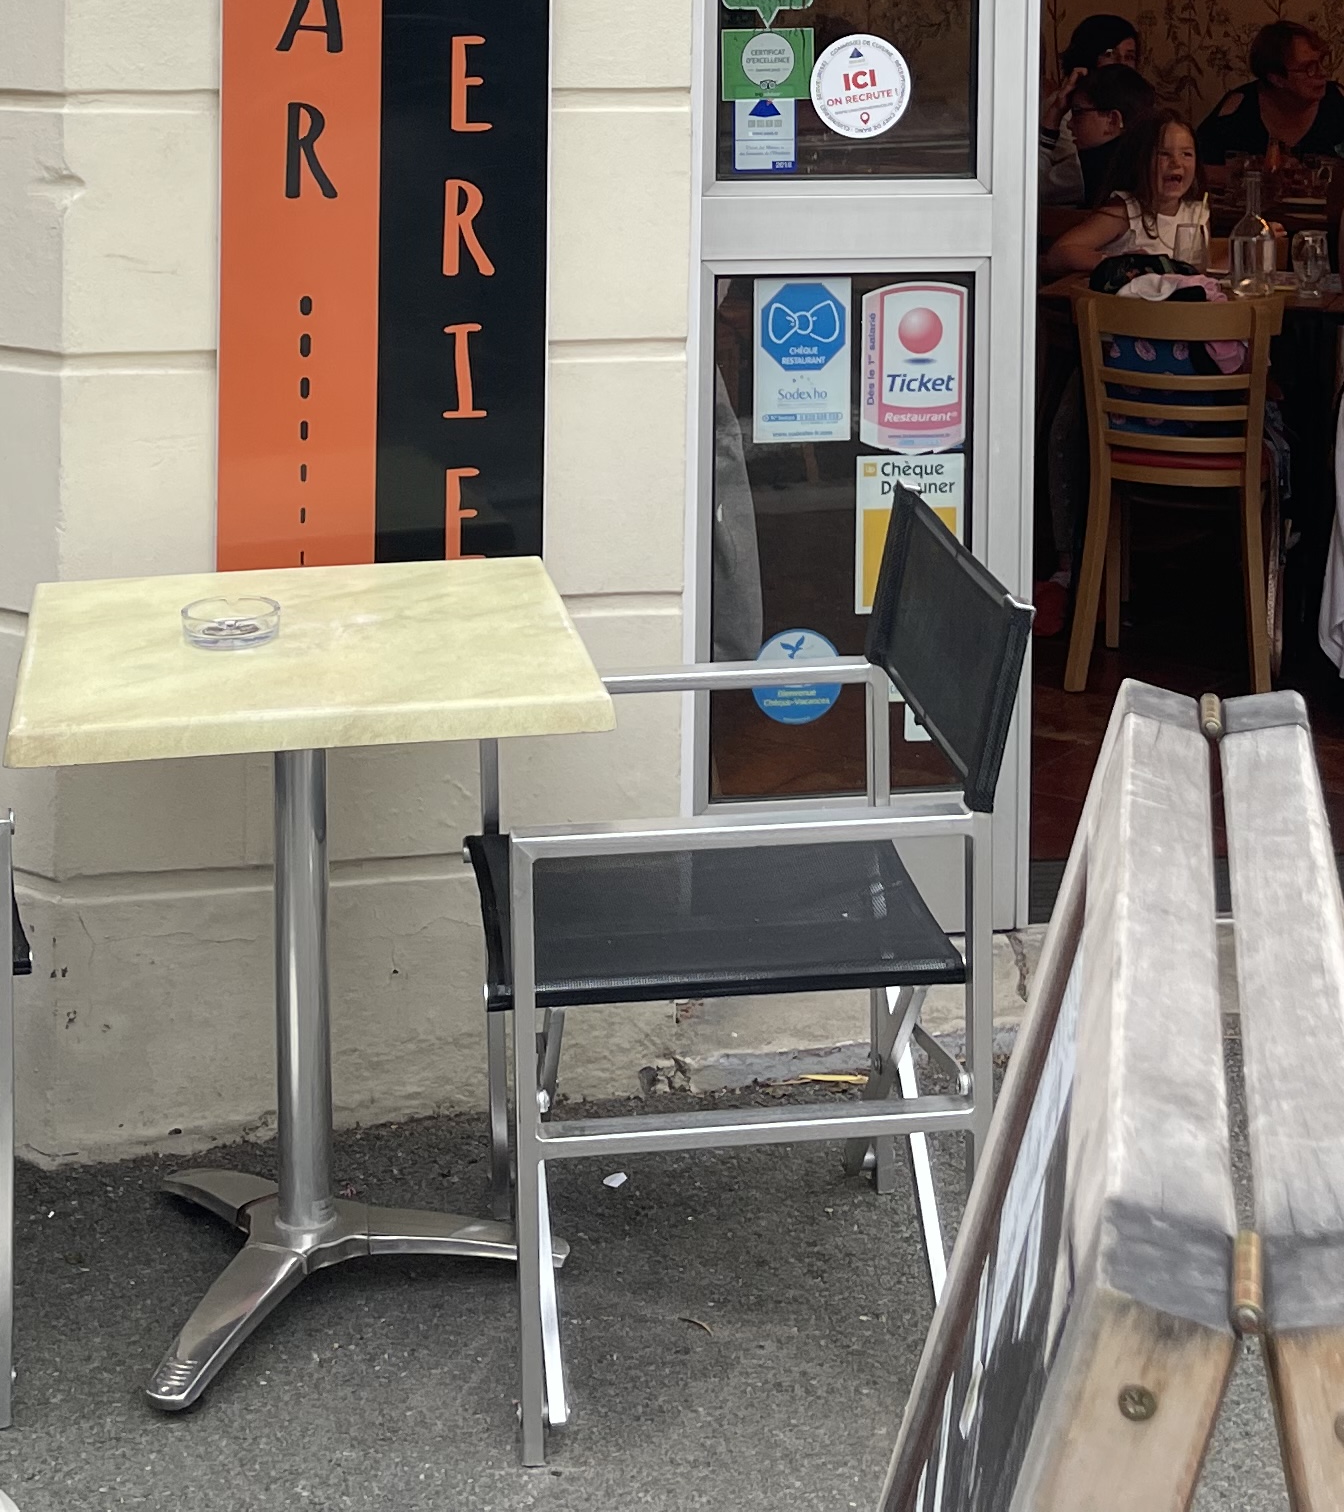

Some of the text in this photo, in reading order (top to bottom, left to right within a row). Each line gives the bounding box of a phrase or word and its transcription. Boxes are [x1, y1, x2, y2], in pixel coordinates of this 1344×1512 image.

[751, 49, 786, 57] CERTIFICAT
[842, 69, 877, 91] ICI
[826, 97, 842, 107] ON
[845, 89, 893, 104] RECRUTE
[789, 344, 818, 355] CHÈQUE
[781, 356, 826, 365] RESTAURANT
[887, 373, 955, 393] Ticket
[881, 461, 945, 479] Chèque
[881, 480, 955, 495] Duner
